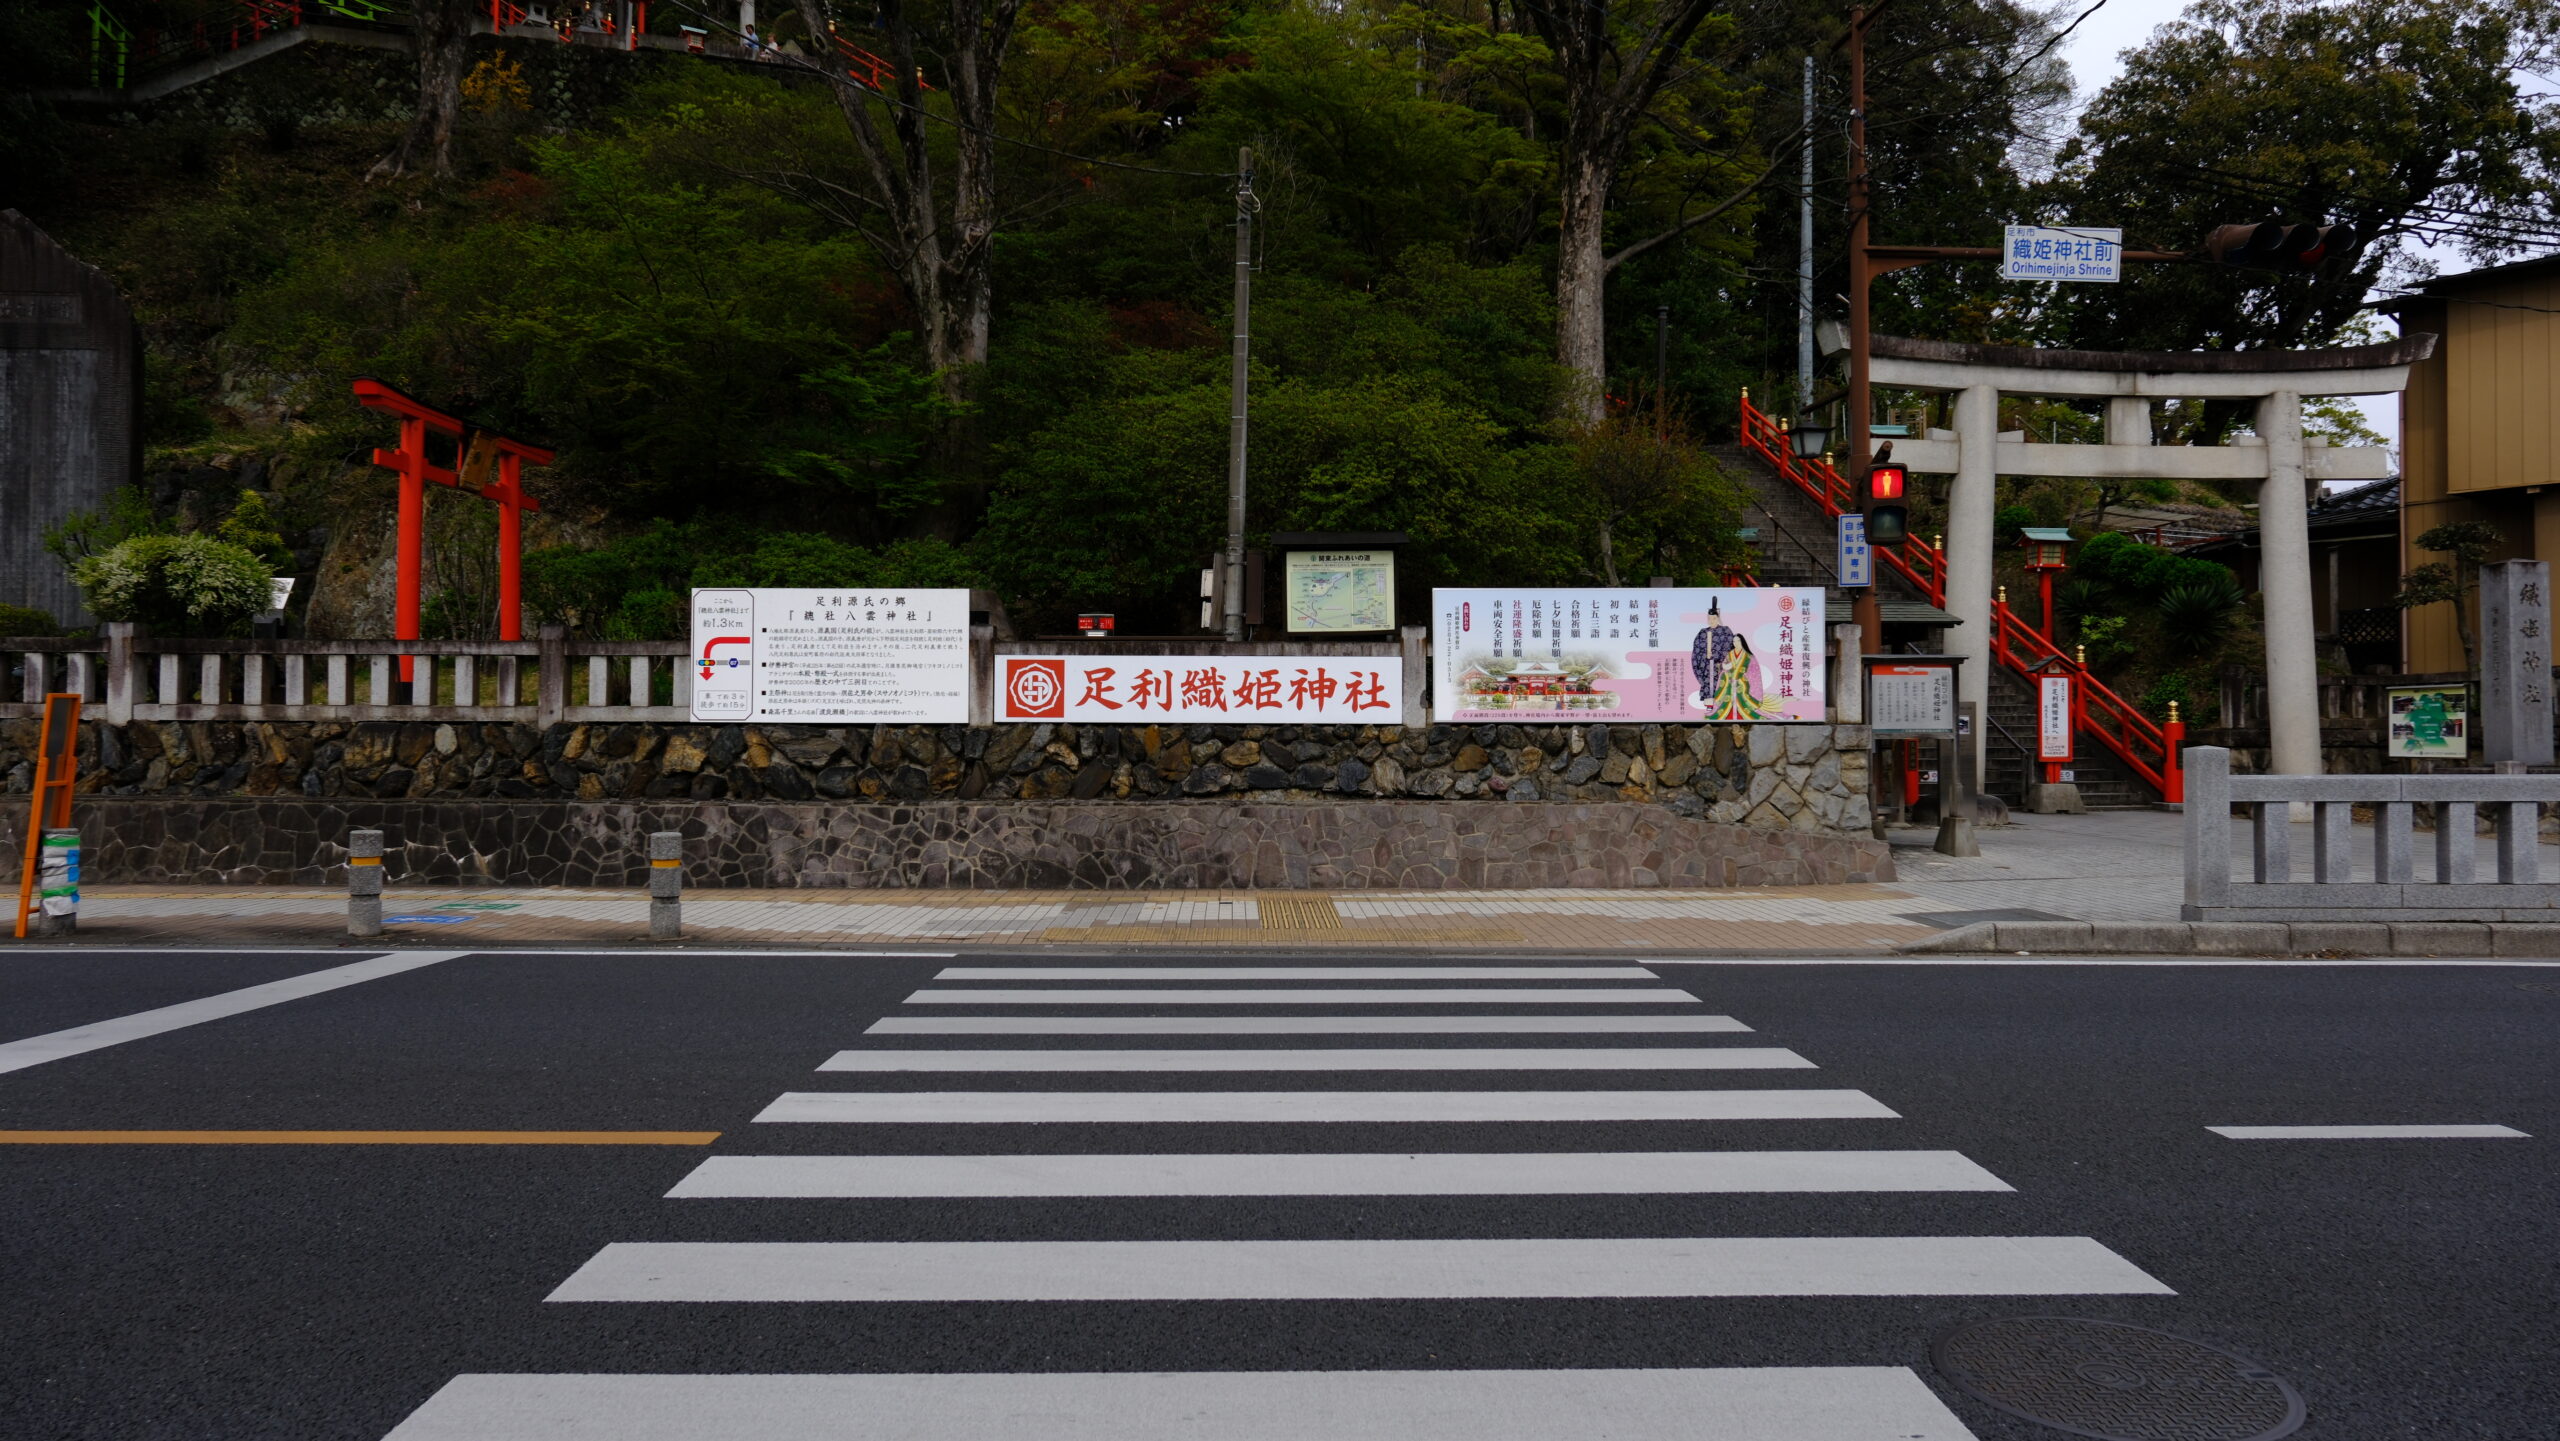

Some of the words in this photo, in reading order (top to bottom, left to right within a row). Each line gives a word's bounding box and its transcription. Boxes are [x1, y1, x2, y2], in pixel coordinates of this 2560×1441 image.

[2006, 227, 2035, 237] 足利市
[2013, 239, 2112, 262] 織姫神社前
[2012, 261, 2075, 277] Orihimejinja
[2078, 263, 2112, 276] Shrine
[1319, 554, 1371, 562] 関東ふれあいの道
[1851, 559, 1859, 579] 専用
[816, 596, 906, 607] 足利源氏の郷
[1532, 600, 1542, 638] 厄除祈願
[1571, 600, 1581, 639] 合格祈願
[1590, 600, 1600, 638] 七五三詣
[1610, 600, 1620, 638] 初宮詣
[1629, 600, 1639, 638] 結婚式
[1493, 600, 1503, 658] 車両安全祈願
[1512, 600, 1523, 658] 社運隆盛祈願
[1551, 600, 1561, 658] 七夕短冊祈願
[1648, 600, 1659, 648] 縁結び祈願
[1779, 616, 1794, 698] 足利織姫神社
[1802, 599, 1811, 697] 縁結びと産業復興の神社
[2519, 582, 2542, 705] 織姫神社
[1074, 666, 1392, 713] 足利織姫神社
